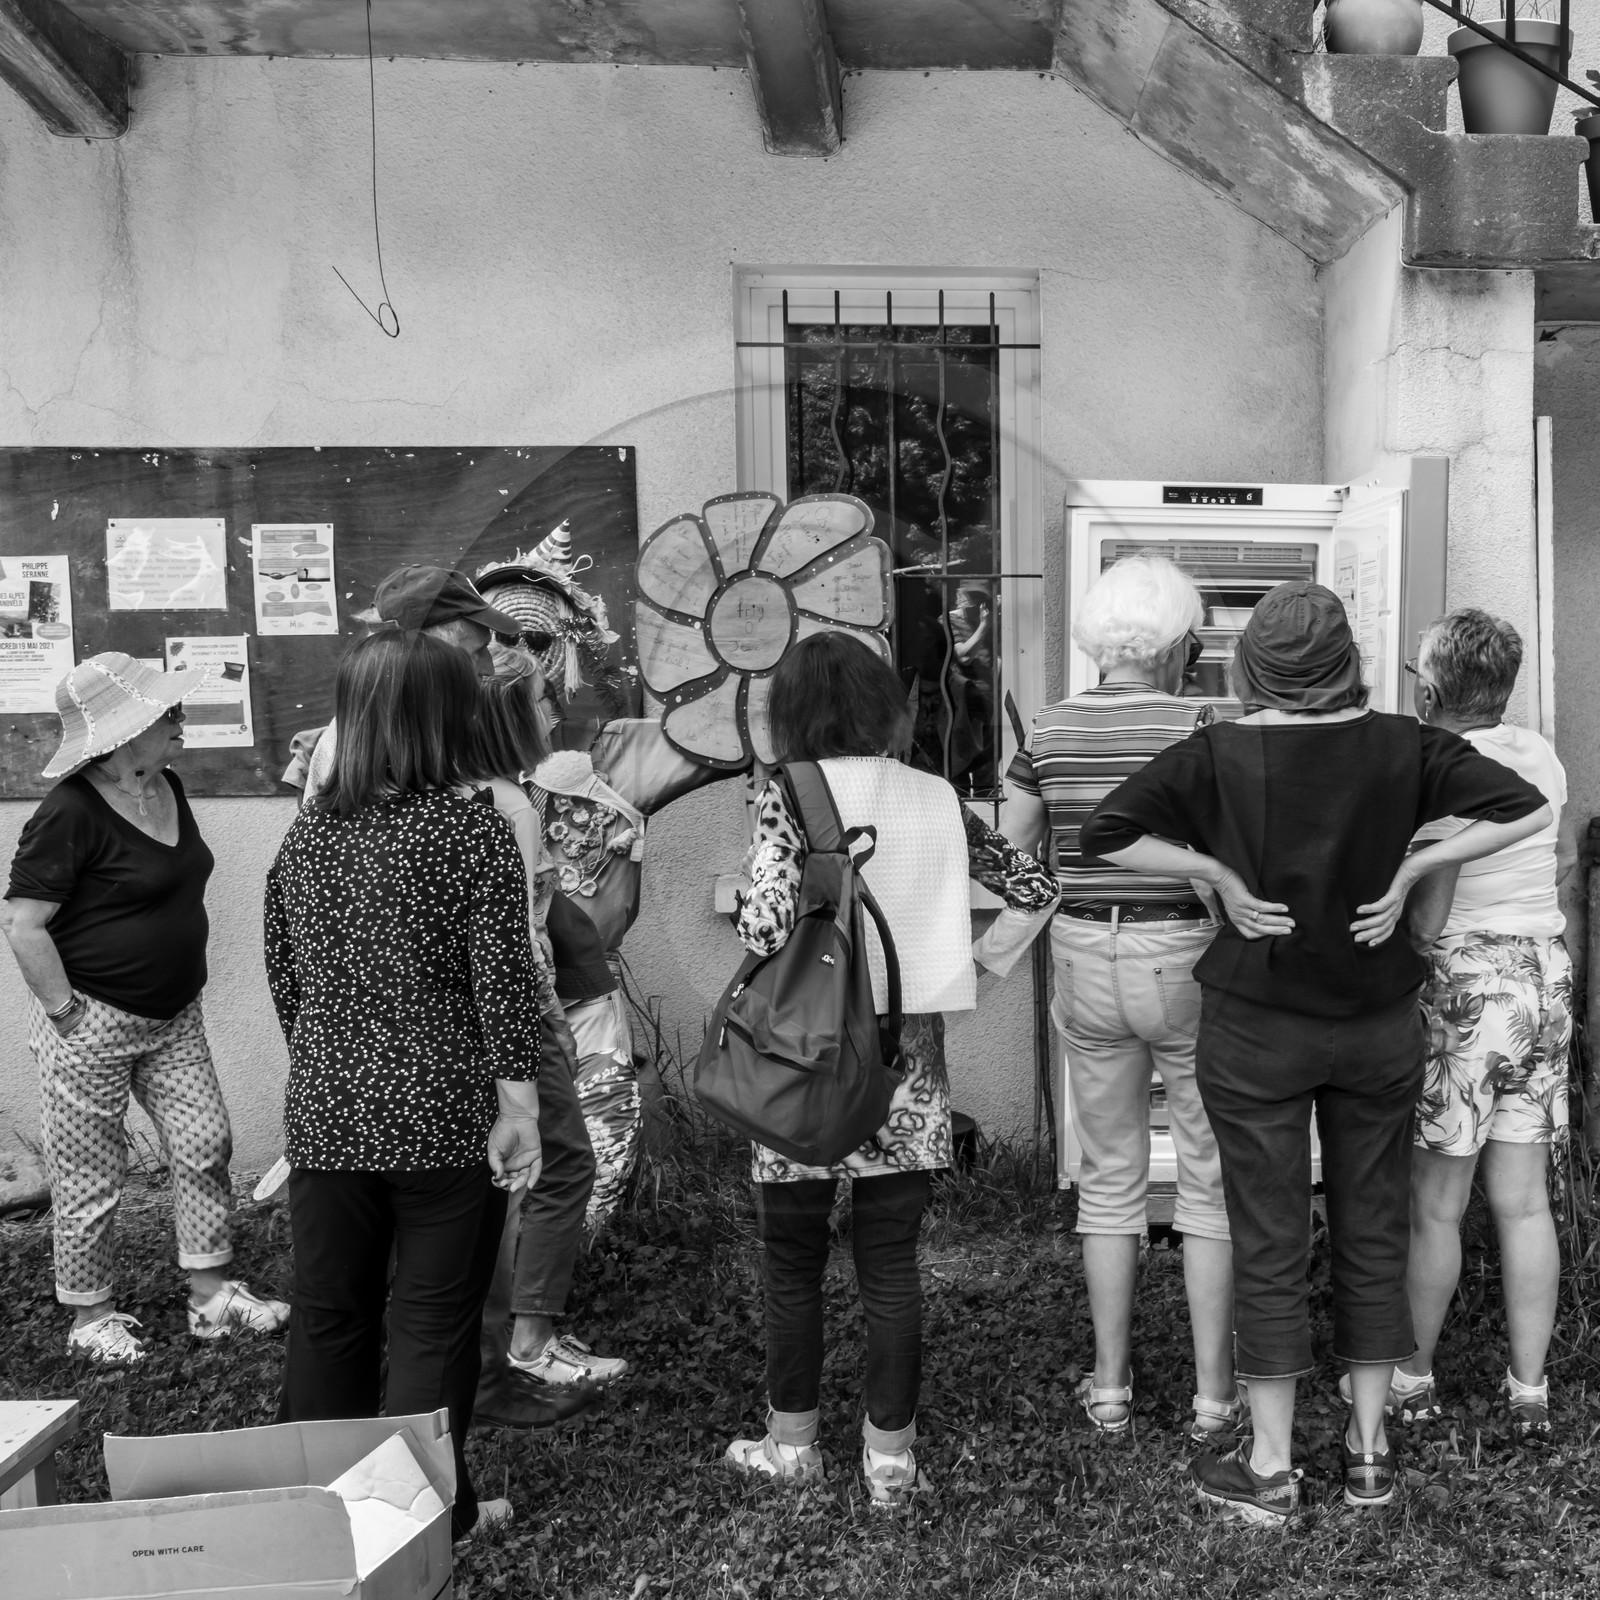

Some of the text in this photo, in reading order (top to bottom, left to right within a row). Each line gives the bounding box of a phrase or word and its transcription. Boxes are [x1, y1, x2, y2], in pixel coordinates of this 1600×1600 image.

[132, 1545, 204, 1557] OPEN WITH CARE
